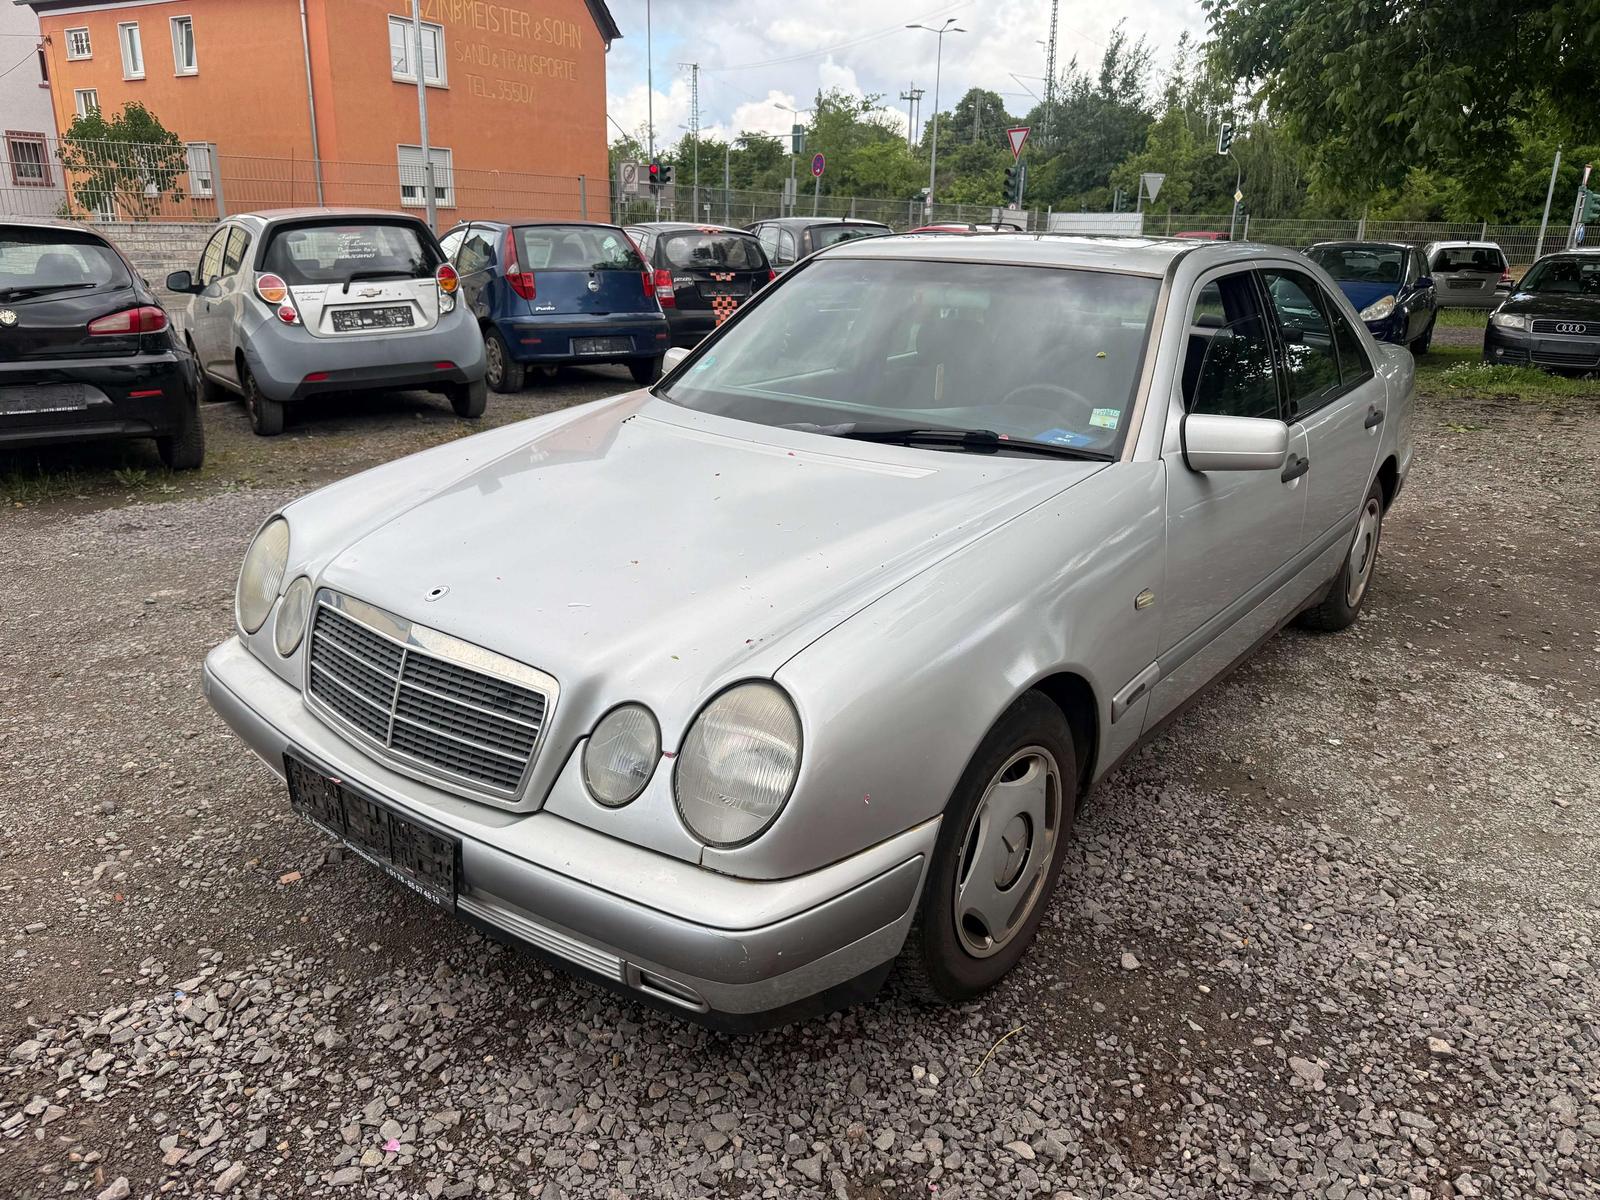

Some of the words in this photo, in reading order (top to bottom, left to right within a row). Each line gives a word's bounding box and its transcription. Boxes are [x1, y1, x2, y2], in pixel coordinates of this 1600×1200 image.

[543, 17, 582, 49] SOHN
[455, 40, 490, 66] SAND
[500, 48, 577, 81] TRANSPORTE
